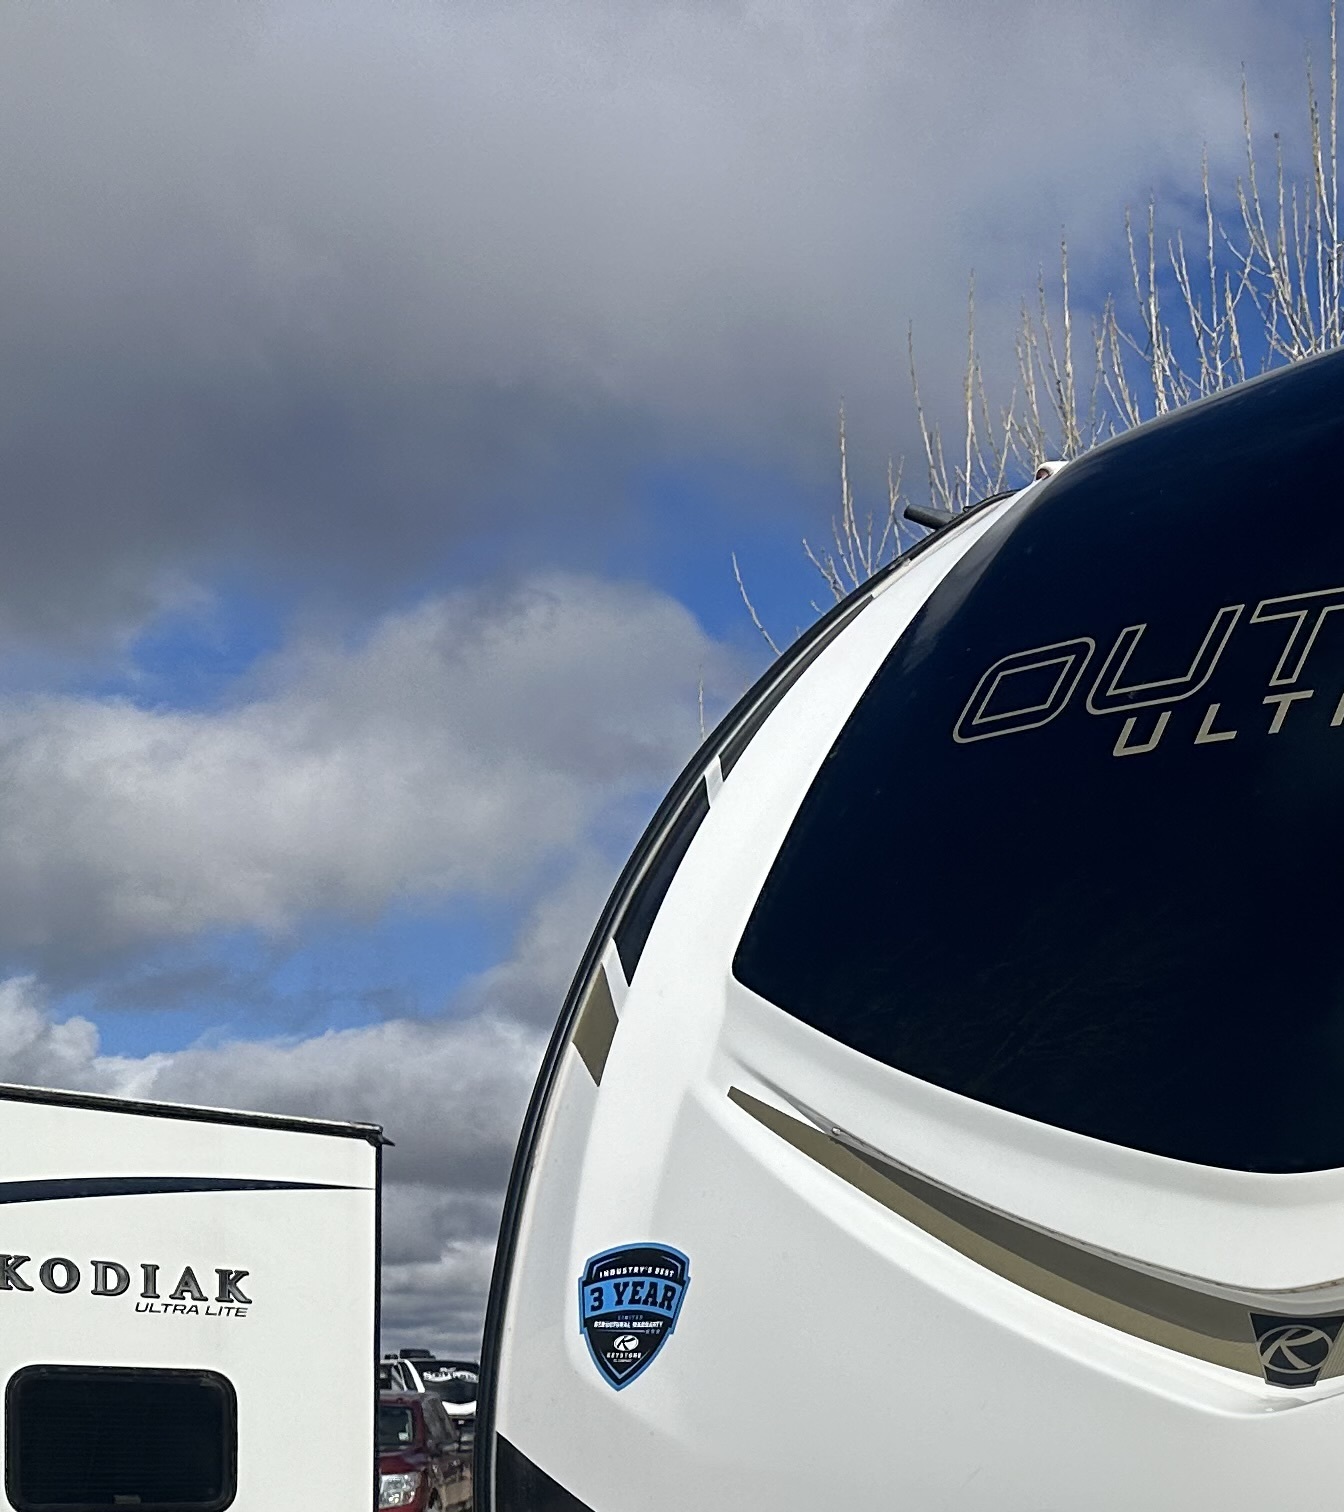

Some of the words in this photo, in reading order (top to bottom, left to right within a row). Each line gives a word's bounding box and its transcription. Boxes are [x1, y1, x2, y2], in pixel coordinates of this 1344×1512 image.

[0, 1253, 252, 1304] KODIAK
[135, 1302, 199, 1316] ULTRA
[205, 1305, 248, 1318] LITE
[590, 1287, 604, 1312] 3
[613, 1281, 677, 1311] YEAR
